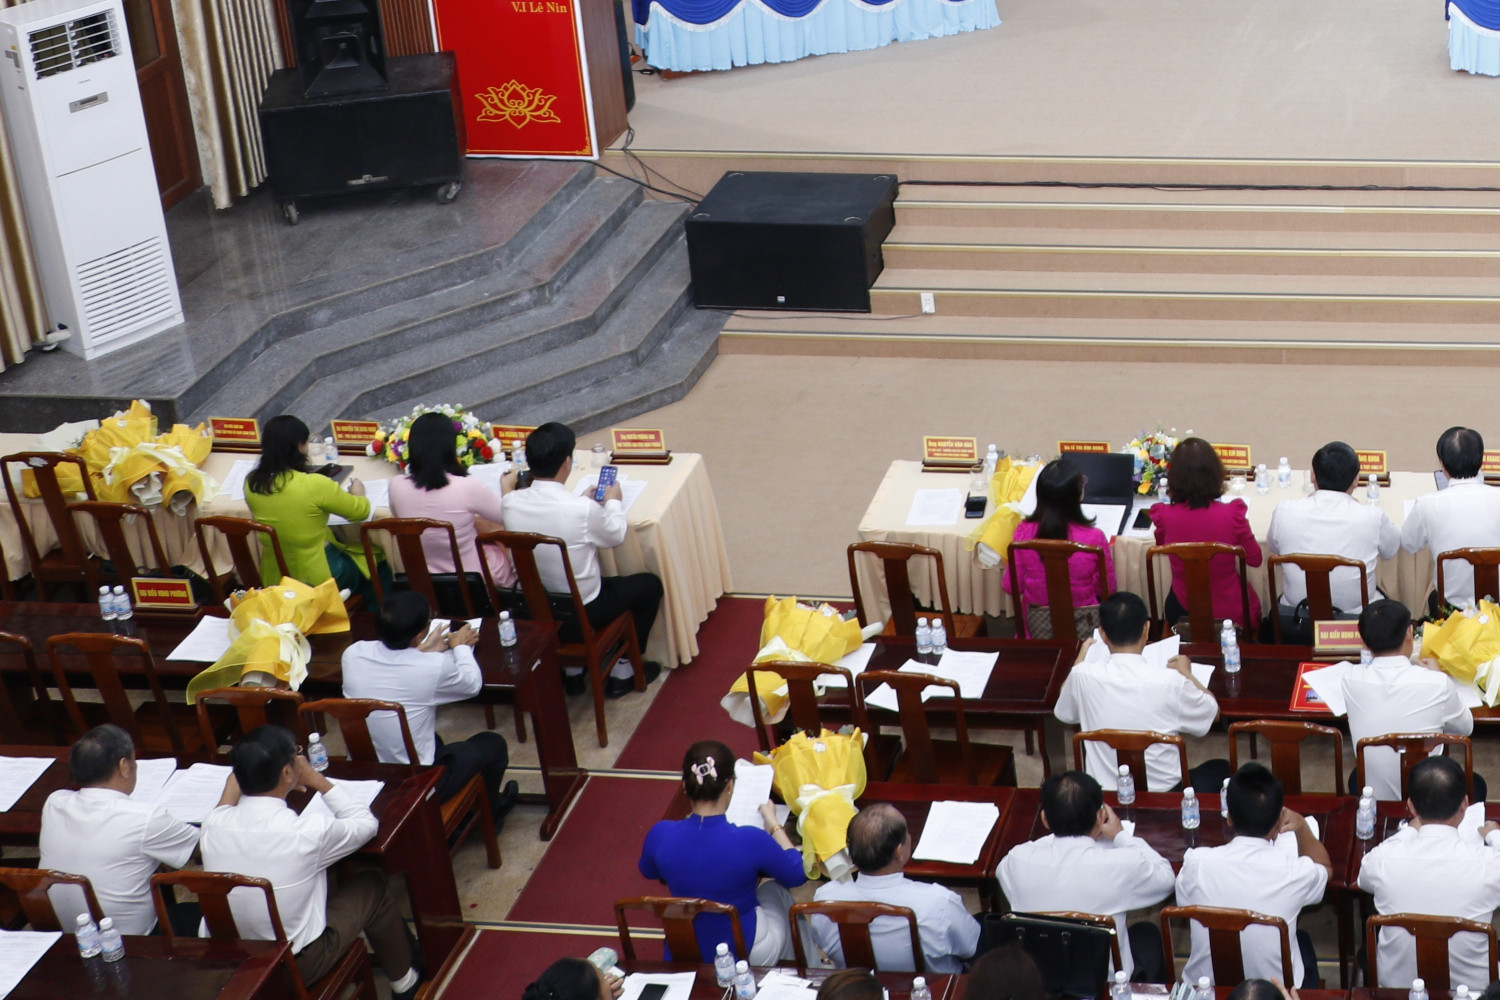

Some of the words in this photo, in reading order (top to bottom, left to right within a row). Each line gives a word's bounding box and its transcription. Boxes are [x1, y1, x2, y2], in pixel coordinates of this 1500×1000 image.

[512, 2, 526, 12] V.I
[529, 2, 543, 12] Lê
[546, 2, 567, 13] Nin
